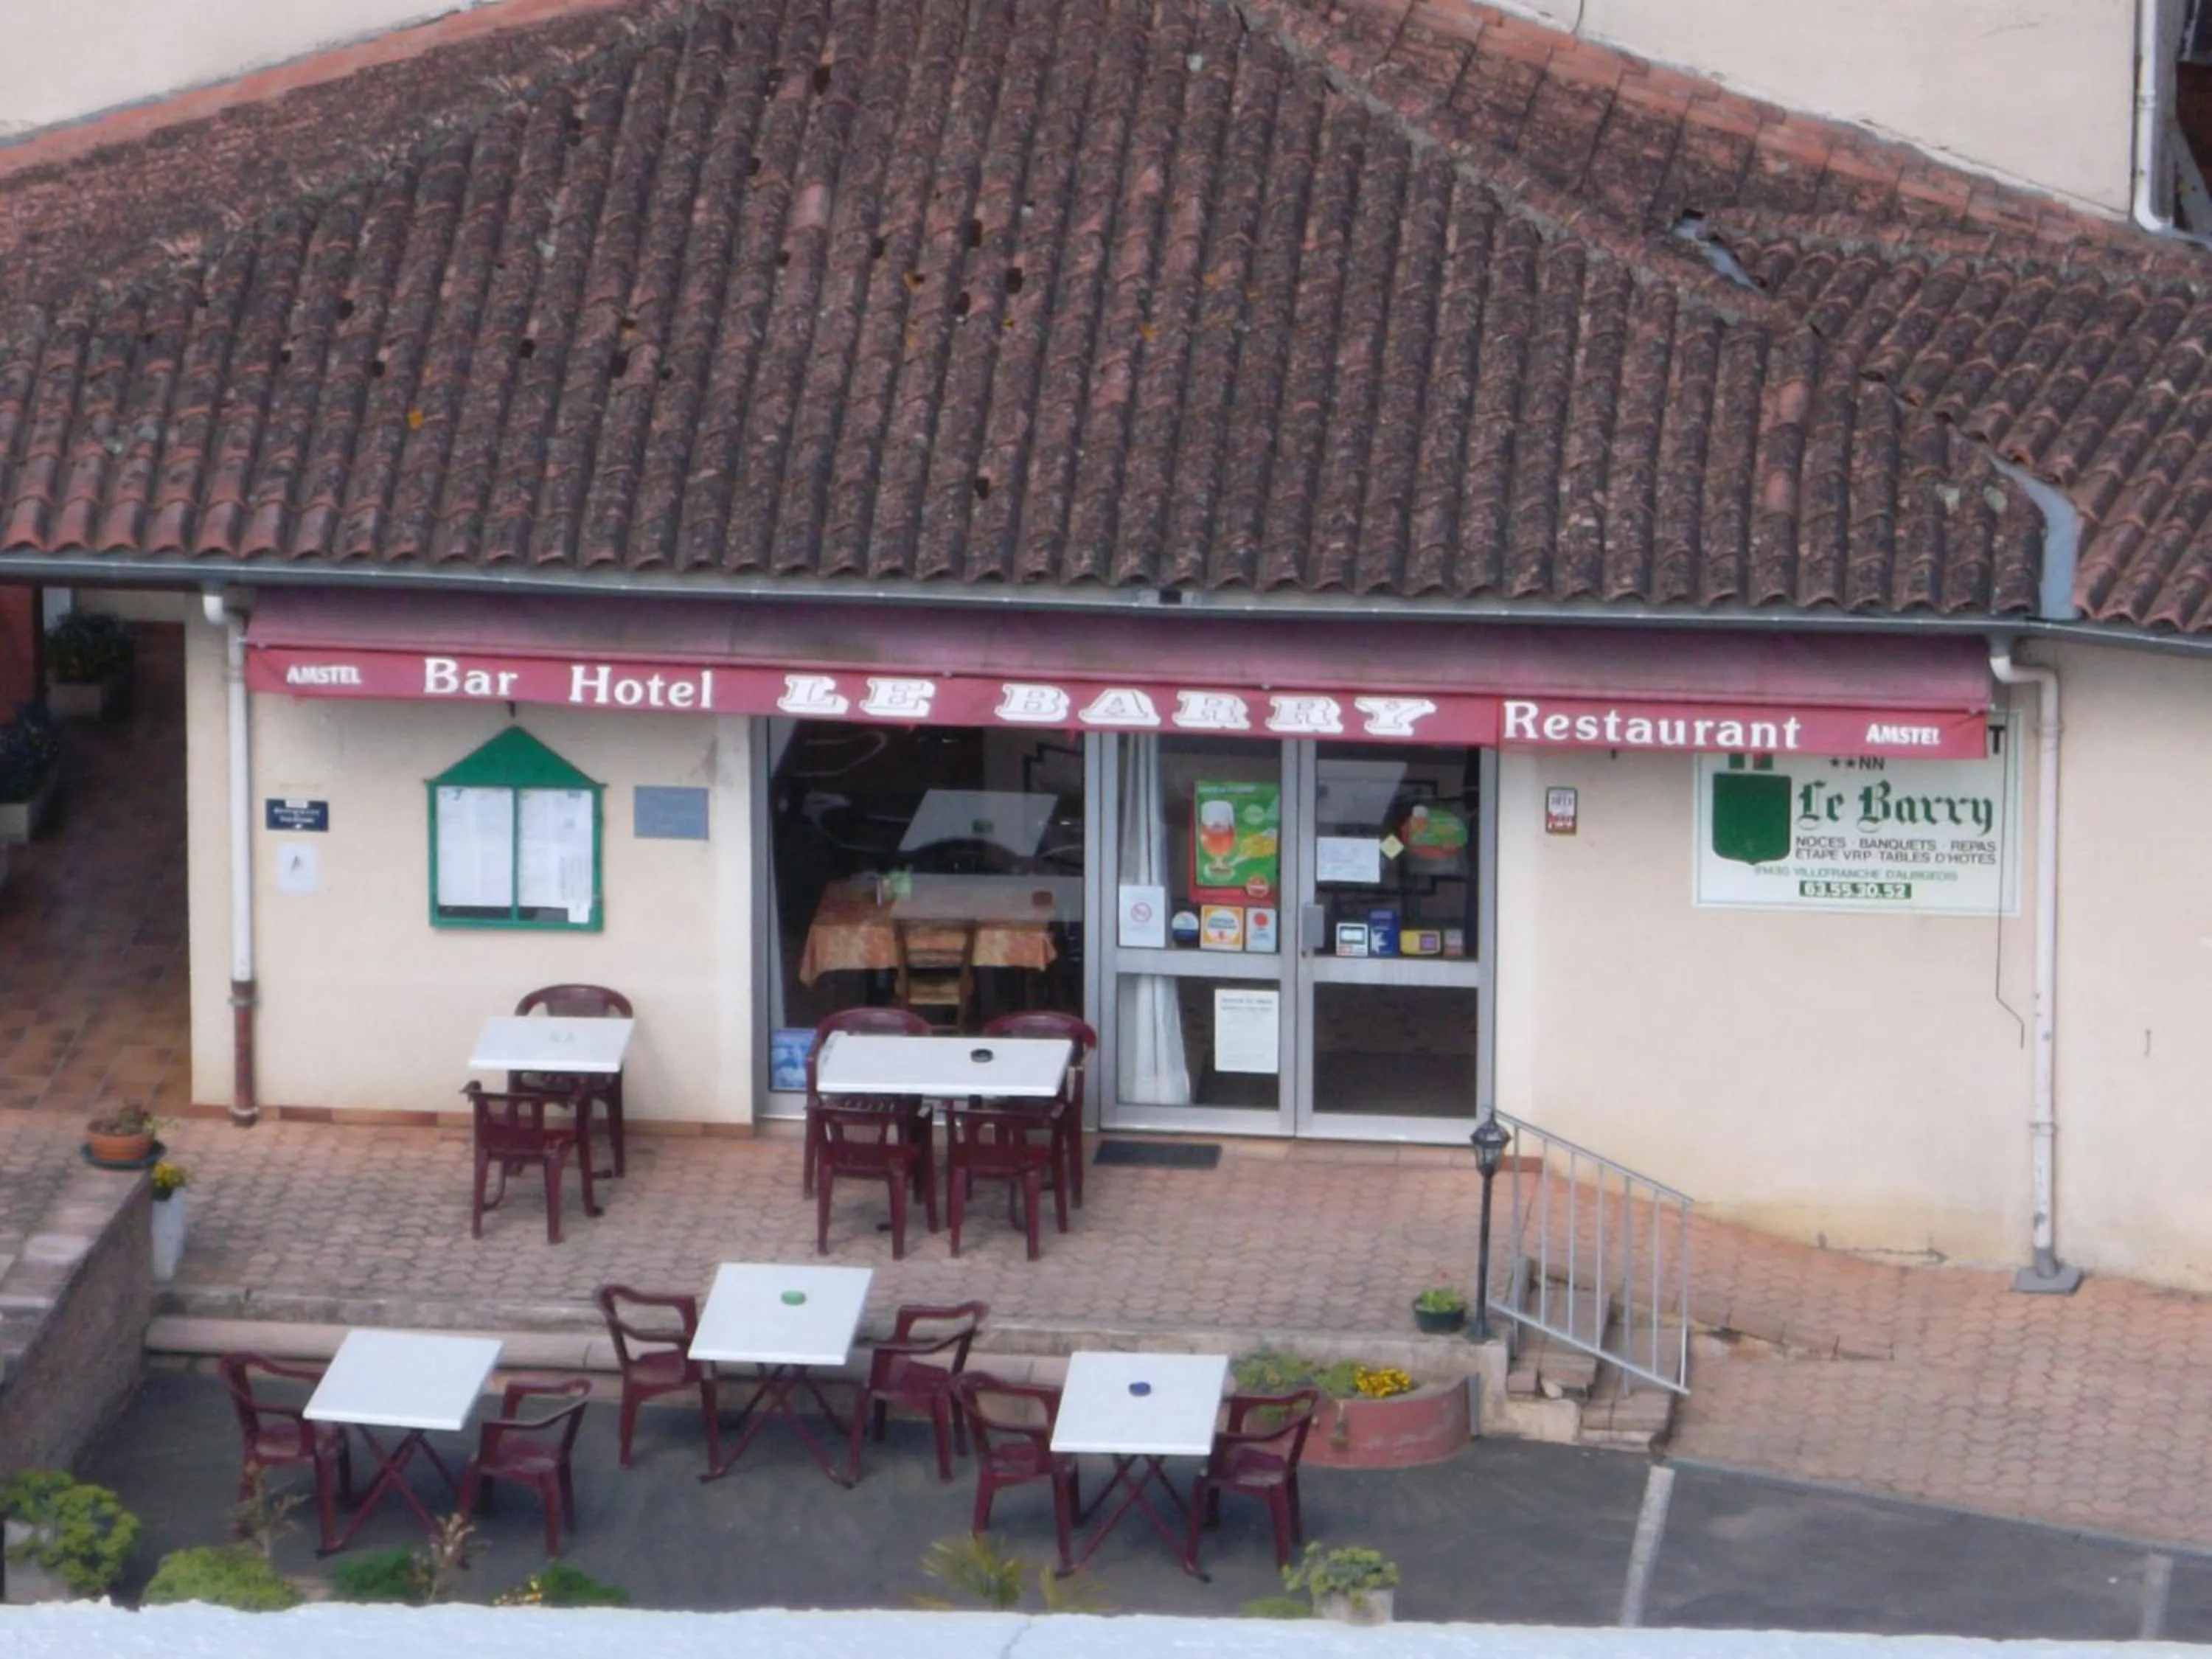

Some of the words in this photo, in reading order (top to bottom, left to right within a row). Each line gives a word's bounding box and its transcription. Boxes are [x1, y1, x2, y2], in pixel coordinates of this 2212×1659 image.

[285, 665, 362, 685] AMSTEL
[423, 656, 518, 696] Bar
[568, 664, 713, 709] Hotel
[776, 675, 935, 718] LE
[993, 683, 1436, 737] BARRY
[1503, 700, 1801, 750] Restaurant
[1865, 723, 1941, 745] AMSTEL
[1797, 780, 1844, 830] Le
[1857, 780, 1993, 836] Barry
[1795, 836, 1846, 848] NOCES
[1859, 838, 1936, 851] BANQUETS
[1950, 841, 1997, 852] REPAS
[1795, 849, 1837, 860] ETAPE
[1844, 850, 1871, 861] VRP
[1879, 851, 1931, 863] TABLES
[1793, 867, 1879, 878] VILLEFRANCHE
